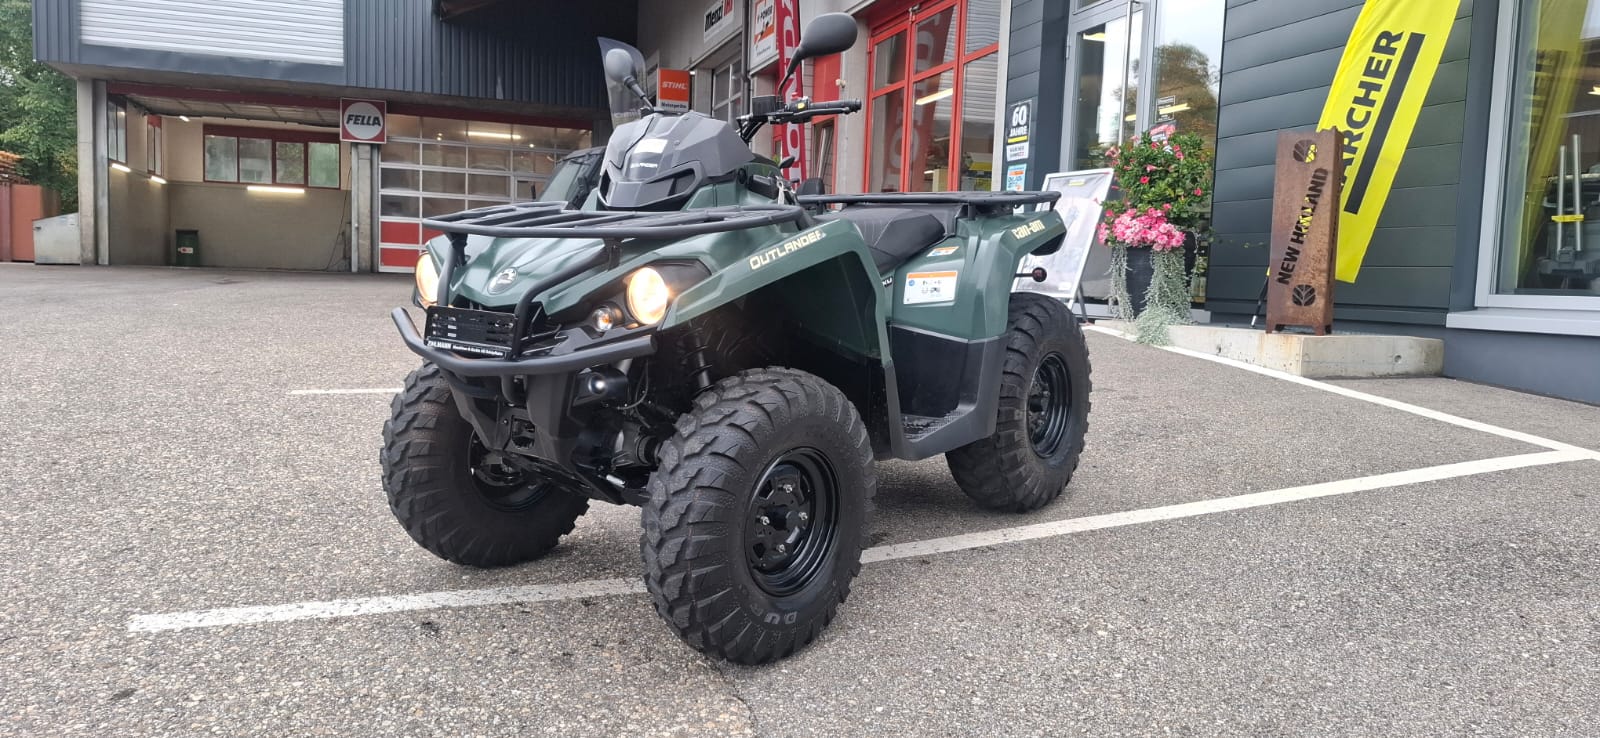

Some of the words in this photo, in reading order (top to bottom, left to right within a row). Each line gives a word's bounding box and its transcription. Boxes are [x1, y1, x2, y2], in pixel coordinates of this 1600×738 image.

[662, 81, 687, 90] STIHL
[1012, 105, 1028, 127] 60
[1340, 30, 1404, 188] RCHER
[346, 114, 381, 127] FELLA
[1009, 125, 1028, 137] JAHRE
[1276, 245, 1300, 285] NEW
[1291, 167, 1328, 245] HOLLAND
